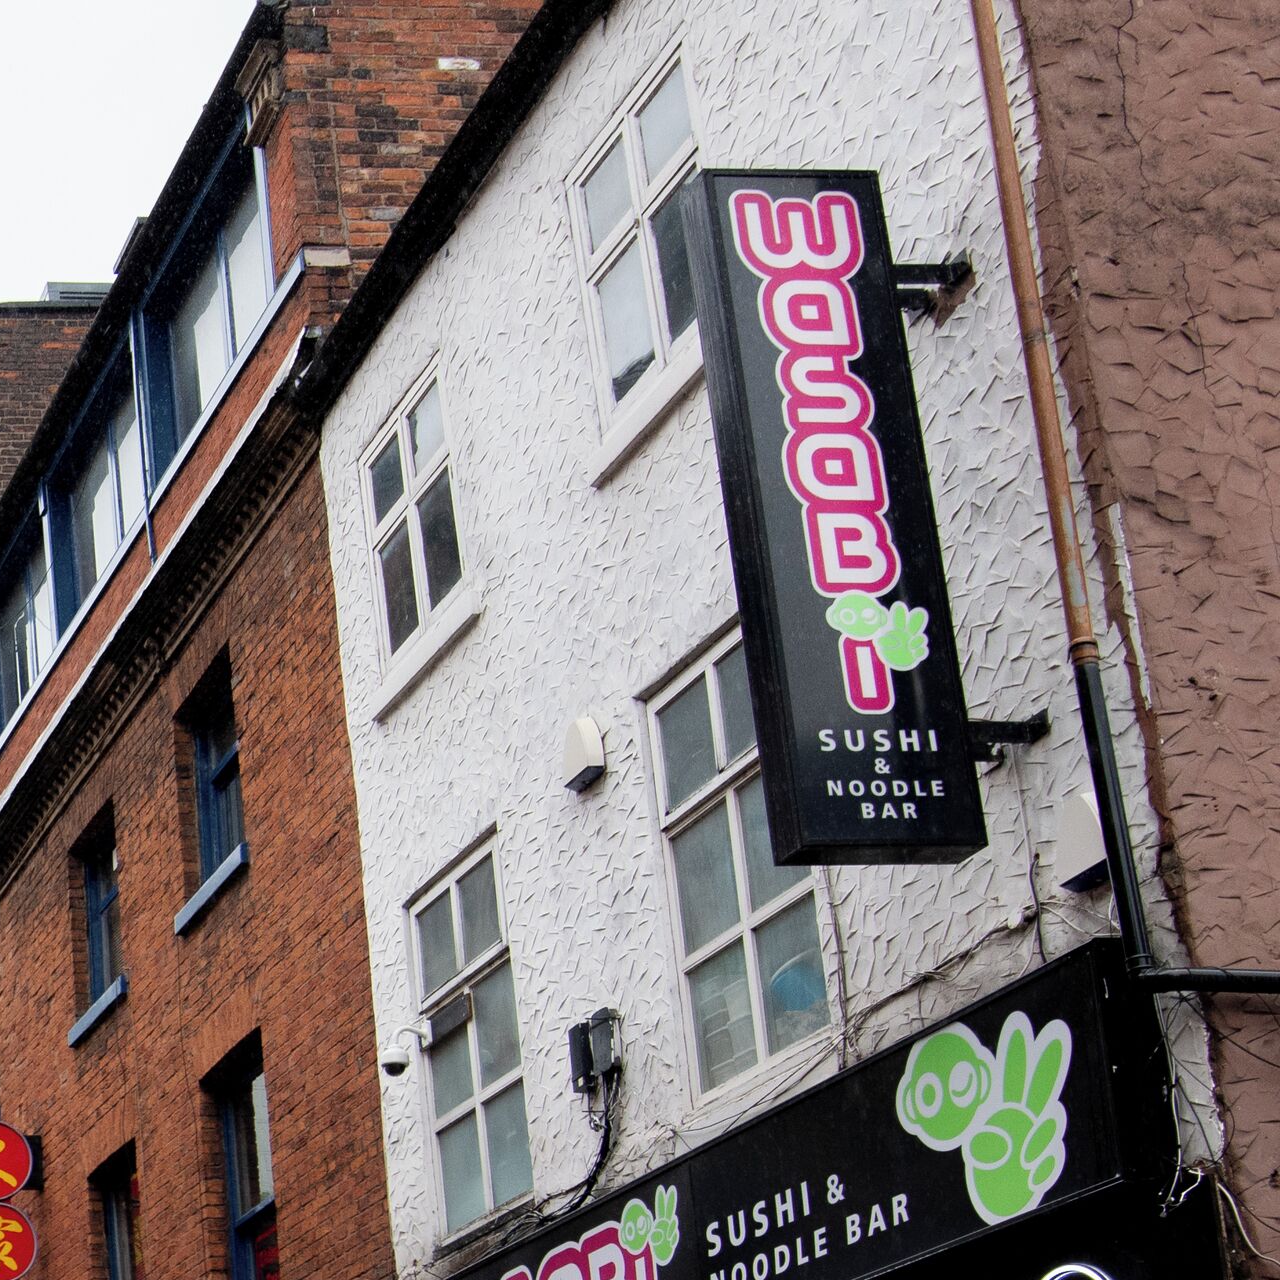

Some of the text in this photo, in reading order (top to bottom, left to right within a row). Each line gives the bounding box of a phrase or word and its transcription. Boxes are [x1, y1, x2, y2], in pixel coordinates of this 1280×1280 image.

[818, 728, 940, 754] SUSHI
[873, 757, 892, 775] &
[826, 778, 946, 798] NOODLE
[860, 800, 919, 821] BAR
[705, 1173, 846, 1259] SUSHI &
[845, 1192, 912, 1247] BAR
